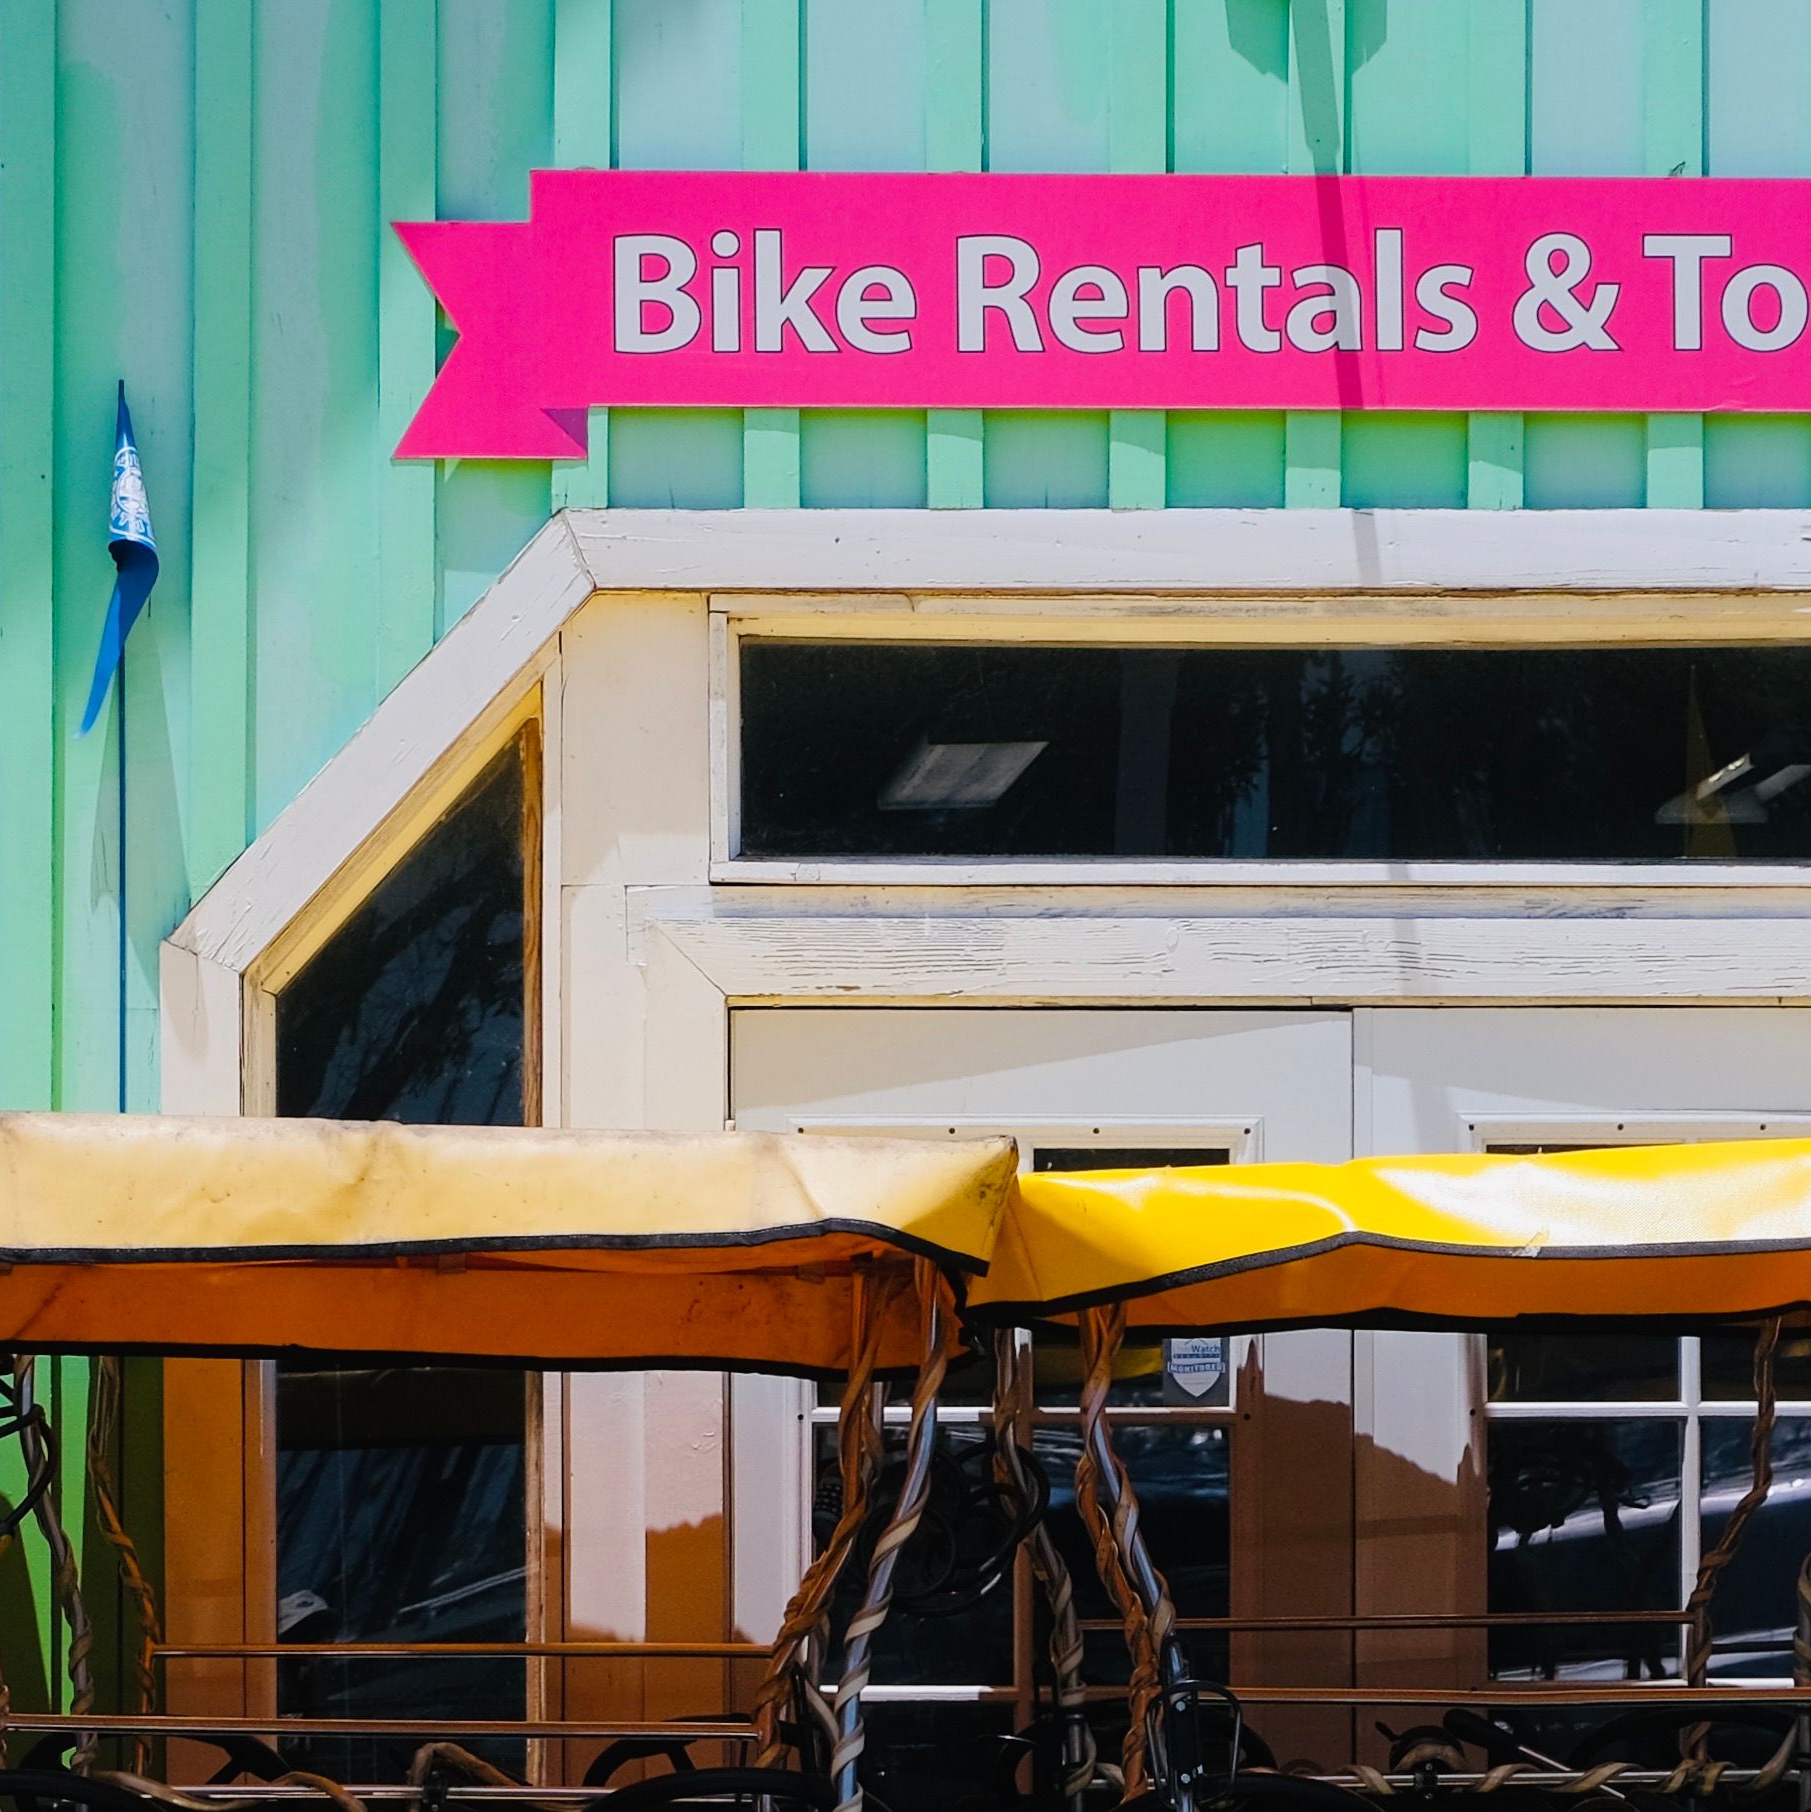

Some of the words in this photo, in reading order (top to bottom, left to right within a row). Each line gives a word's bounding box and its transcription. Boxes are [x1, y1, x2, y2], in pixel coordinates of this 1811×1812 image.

[613, 228, 918, 354] Bike
[956, 227, 1478, 354] Rentals
[1512, 231, 1624, 353] &
